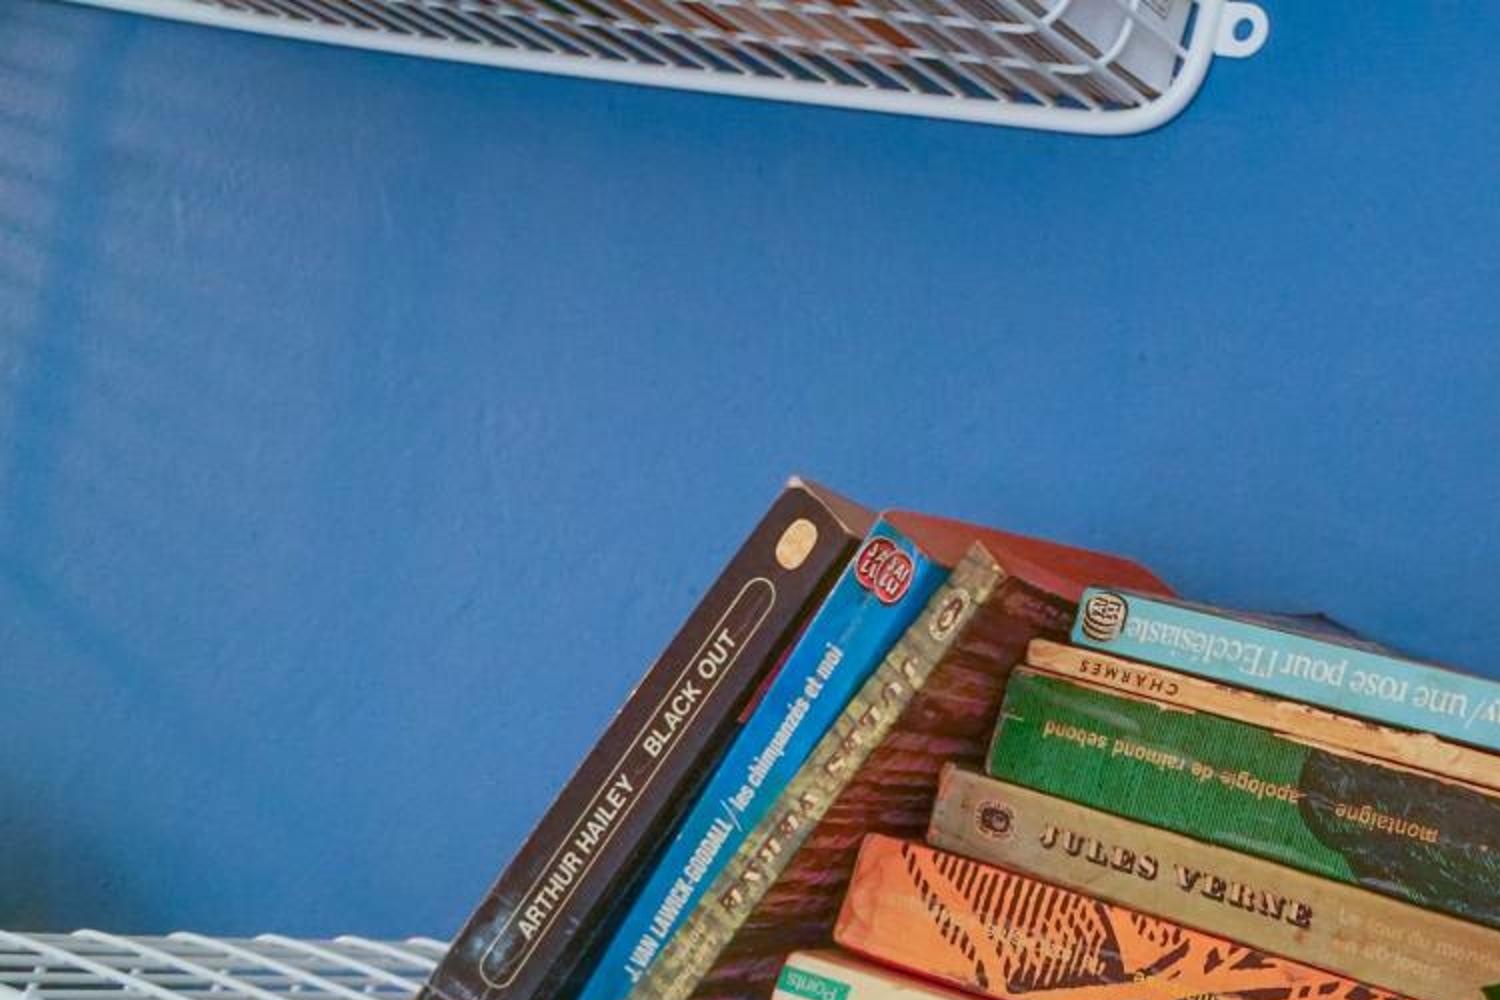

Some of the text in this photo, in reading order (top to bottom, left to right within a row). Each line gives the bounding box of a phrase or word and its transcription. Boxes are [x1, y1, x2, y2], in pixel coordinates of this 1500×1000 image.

[810, 640, 846, 681] moi
[1077, 658, 1180, 697] CHARMES
[1279, 646, 1348, 690] pour
[798, 674, 825, 700] et
[1348, 667, 1409, 704] rose
[1411, 681, 1470, 716] une
[513, 627, 741, 940] ARTHUR HAILEY BLACK OUT
[714, 652, 926, 916] JULES VERNE
[1041, 718, 1440, 845] montaigne apologie de raimond sebond
[1036, 821, 1316, 931] JULES VERNE
